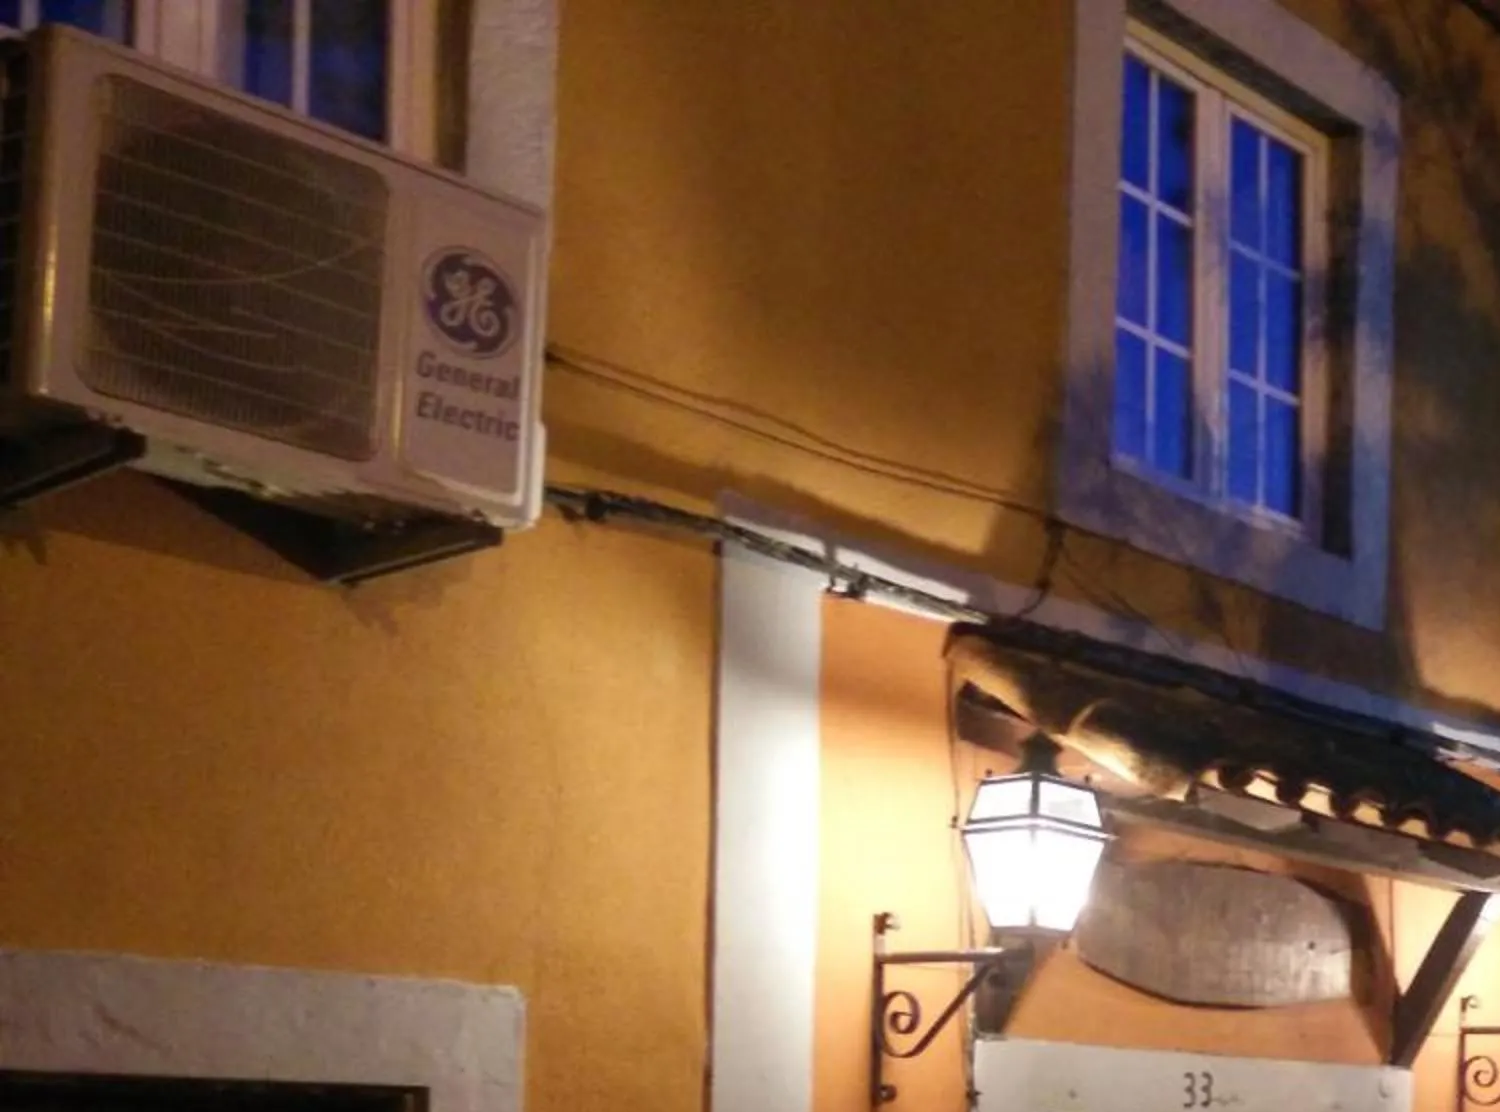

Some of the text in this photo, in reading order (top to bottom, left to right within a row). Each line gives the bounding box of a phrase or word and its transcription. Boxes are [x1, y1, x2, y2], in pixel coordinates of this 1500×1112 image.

[416, 351, 520, 399] General
[416, 391, 520, 441] Electric
[1183, 1071, 1214, 1108] 33
